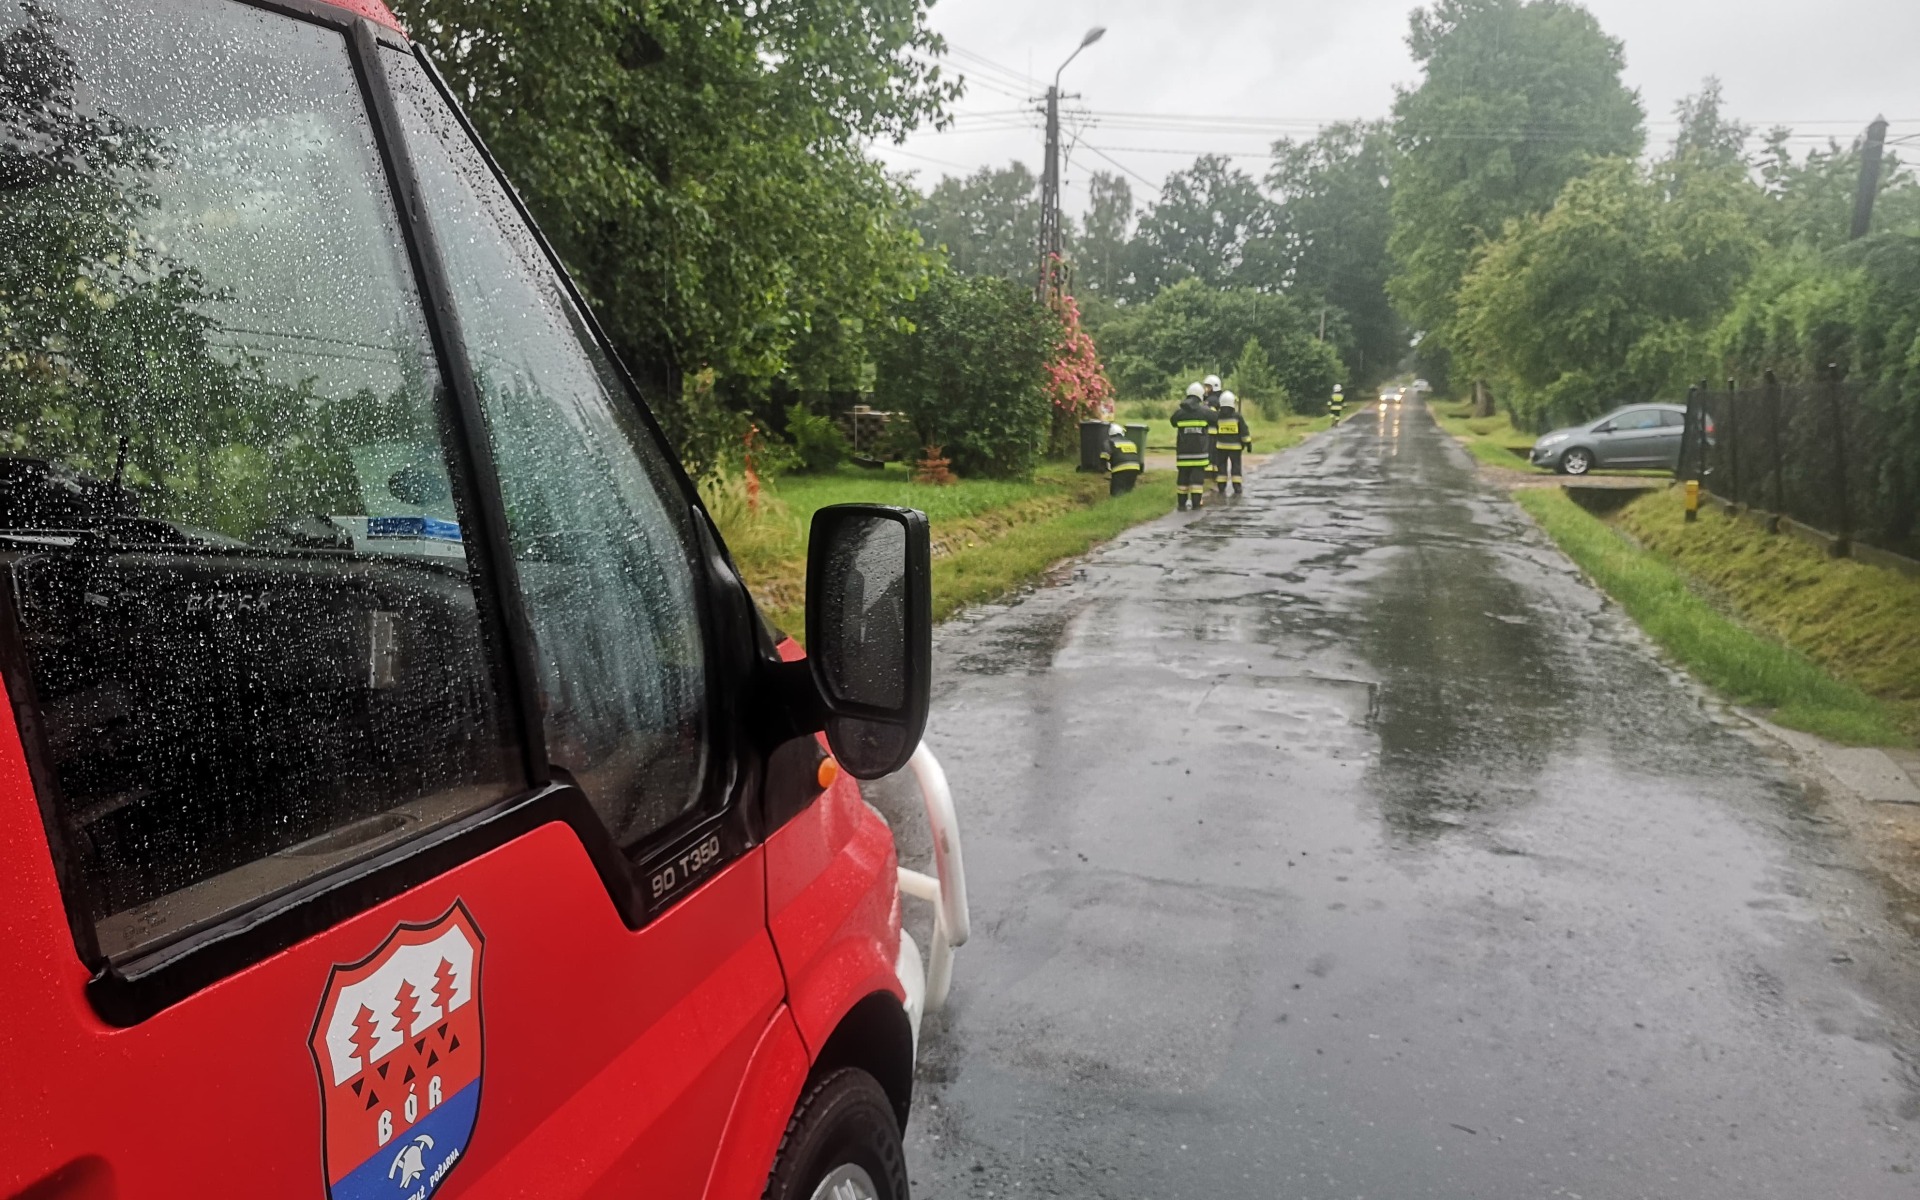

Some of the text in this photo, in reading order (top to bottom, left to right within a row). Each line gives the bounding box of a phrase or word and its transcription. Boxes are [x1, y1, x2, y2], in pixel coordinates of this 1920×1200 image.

[652, 836, 720, 898] 90 T350
[378, 1076, 443, 1147] BÓR
[429, 1147, 460, 1188] POŻARNA
